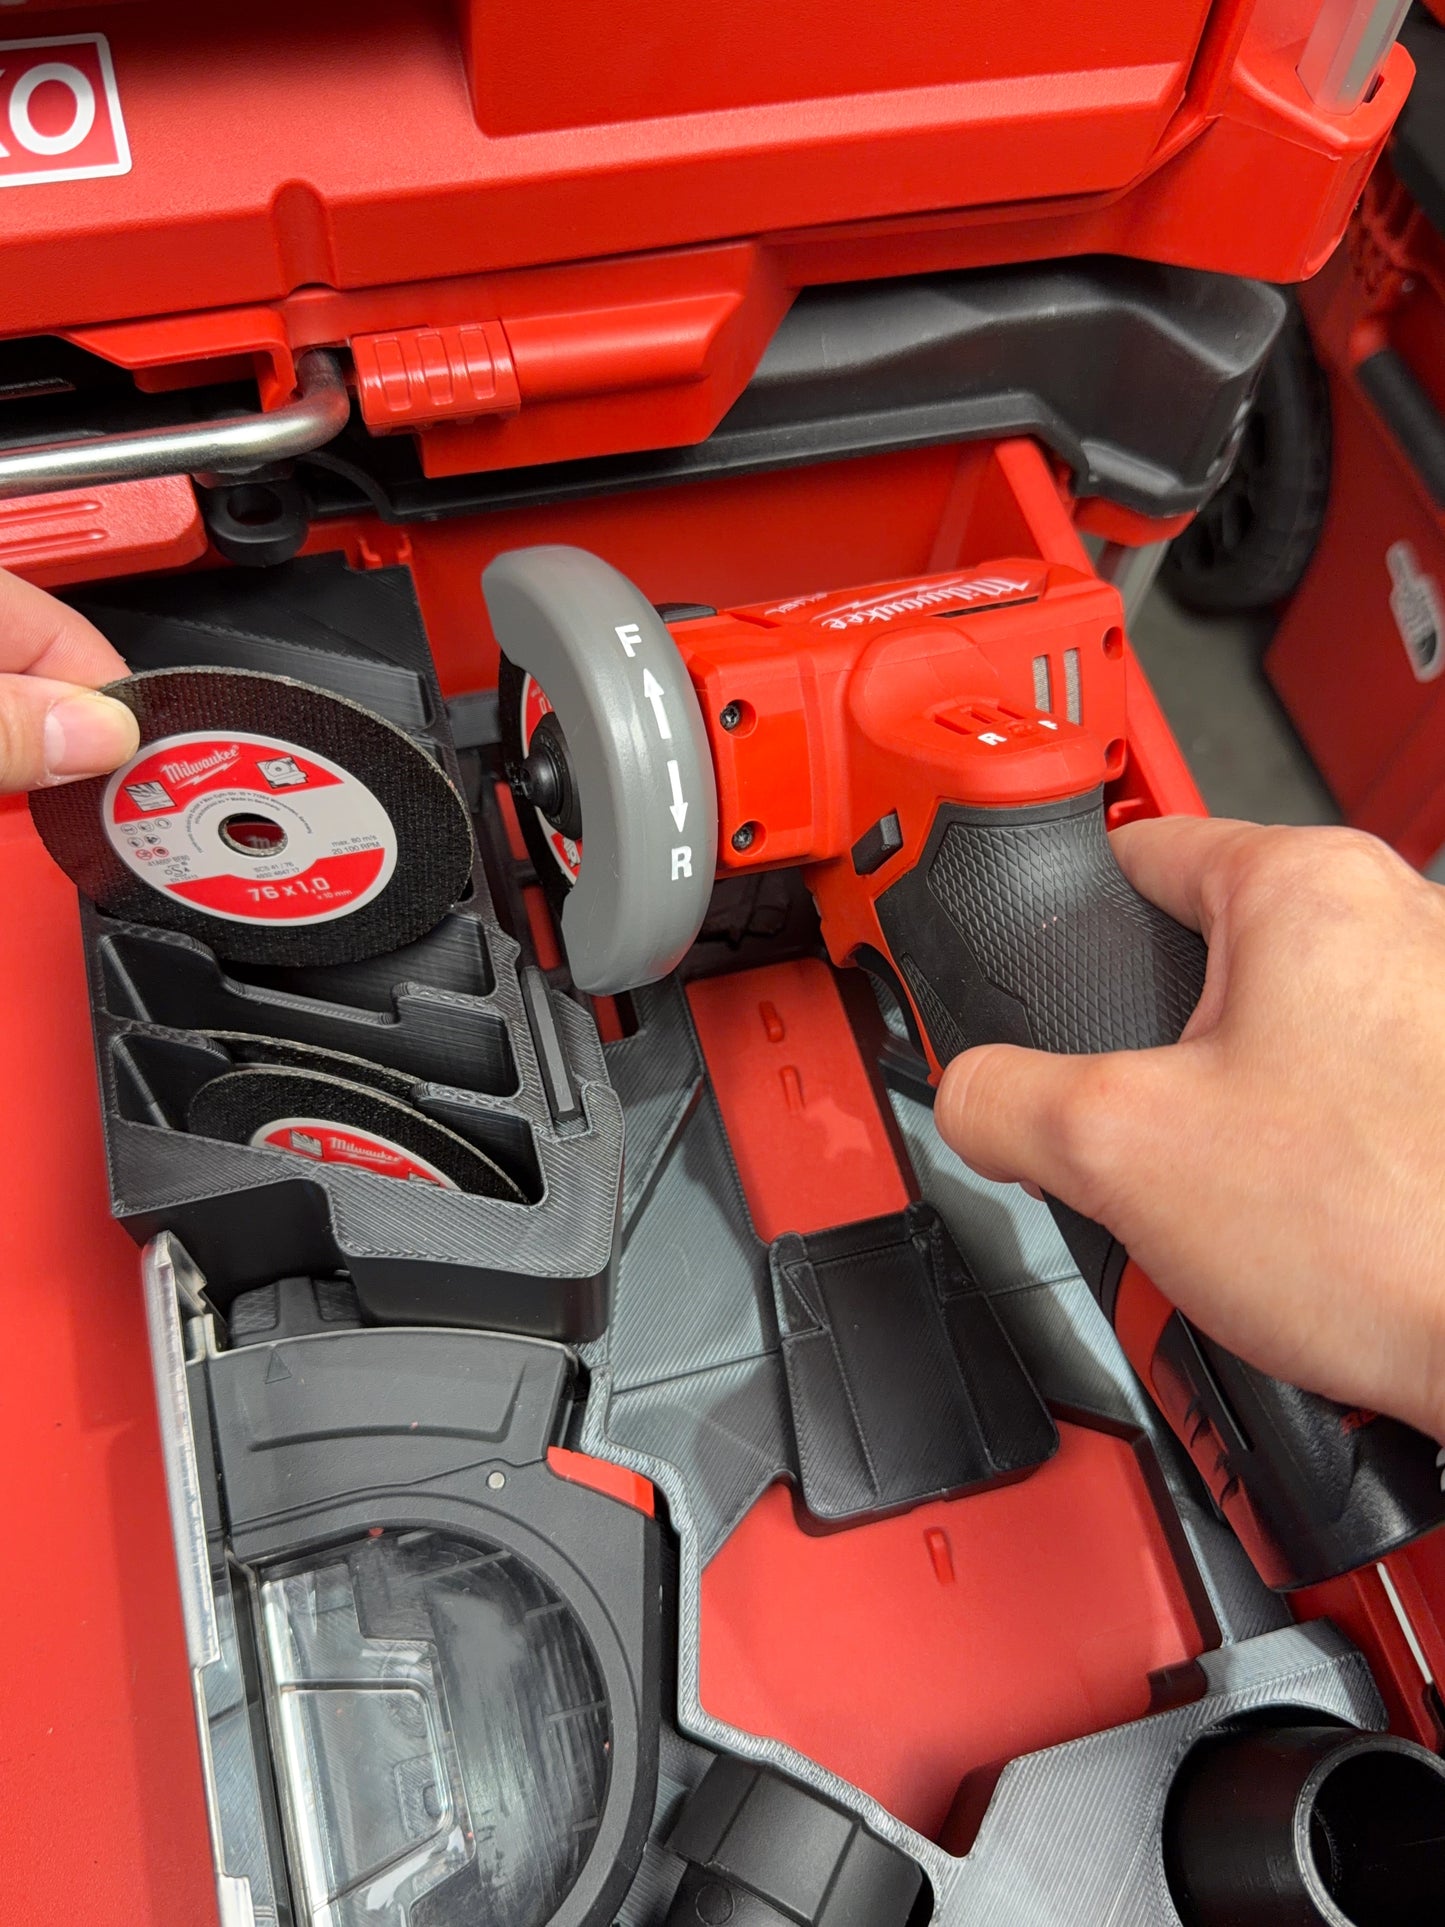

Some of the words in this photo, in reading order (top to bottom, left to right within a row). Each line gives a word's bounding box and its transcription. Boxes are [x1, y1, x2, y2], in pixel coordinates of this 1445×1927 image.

[821, 577, 1030, 630] Milwaukee
[614, 623, 642, 658] F
[977, 732, 1007, 746] R
[160, 746, 238, 783] Milwaukee
[331, 840, 350, 848] max.
[362, 834, 378, 842] m/s
[344, 844, 360, 852] 100
[360, 841, 381, 850] RPM
[671, 845, 693, 880] R
[247, 885, 279, 902] 76
[281, 885, 297, 897] x
[296, 876, 330, 895] 1,0
[335, 888, 353, 897] mm
[328, 1137, 400, 1163] Milwaukee
